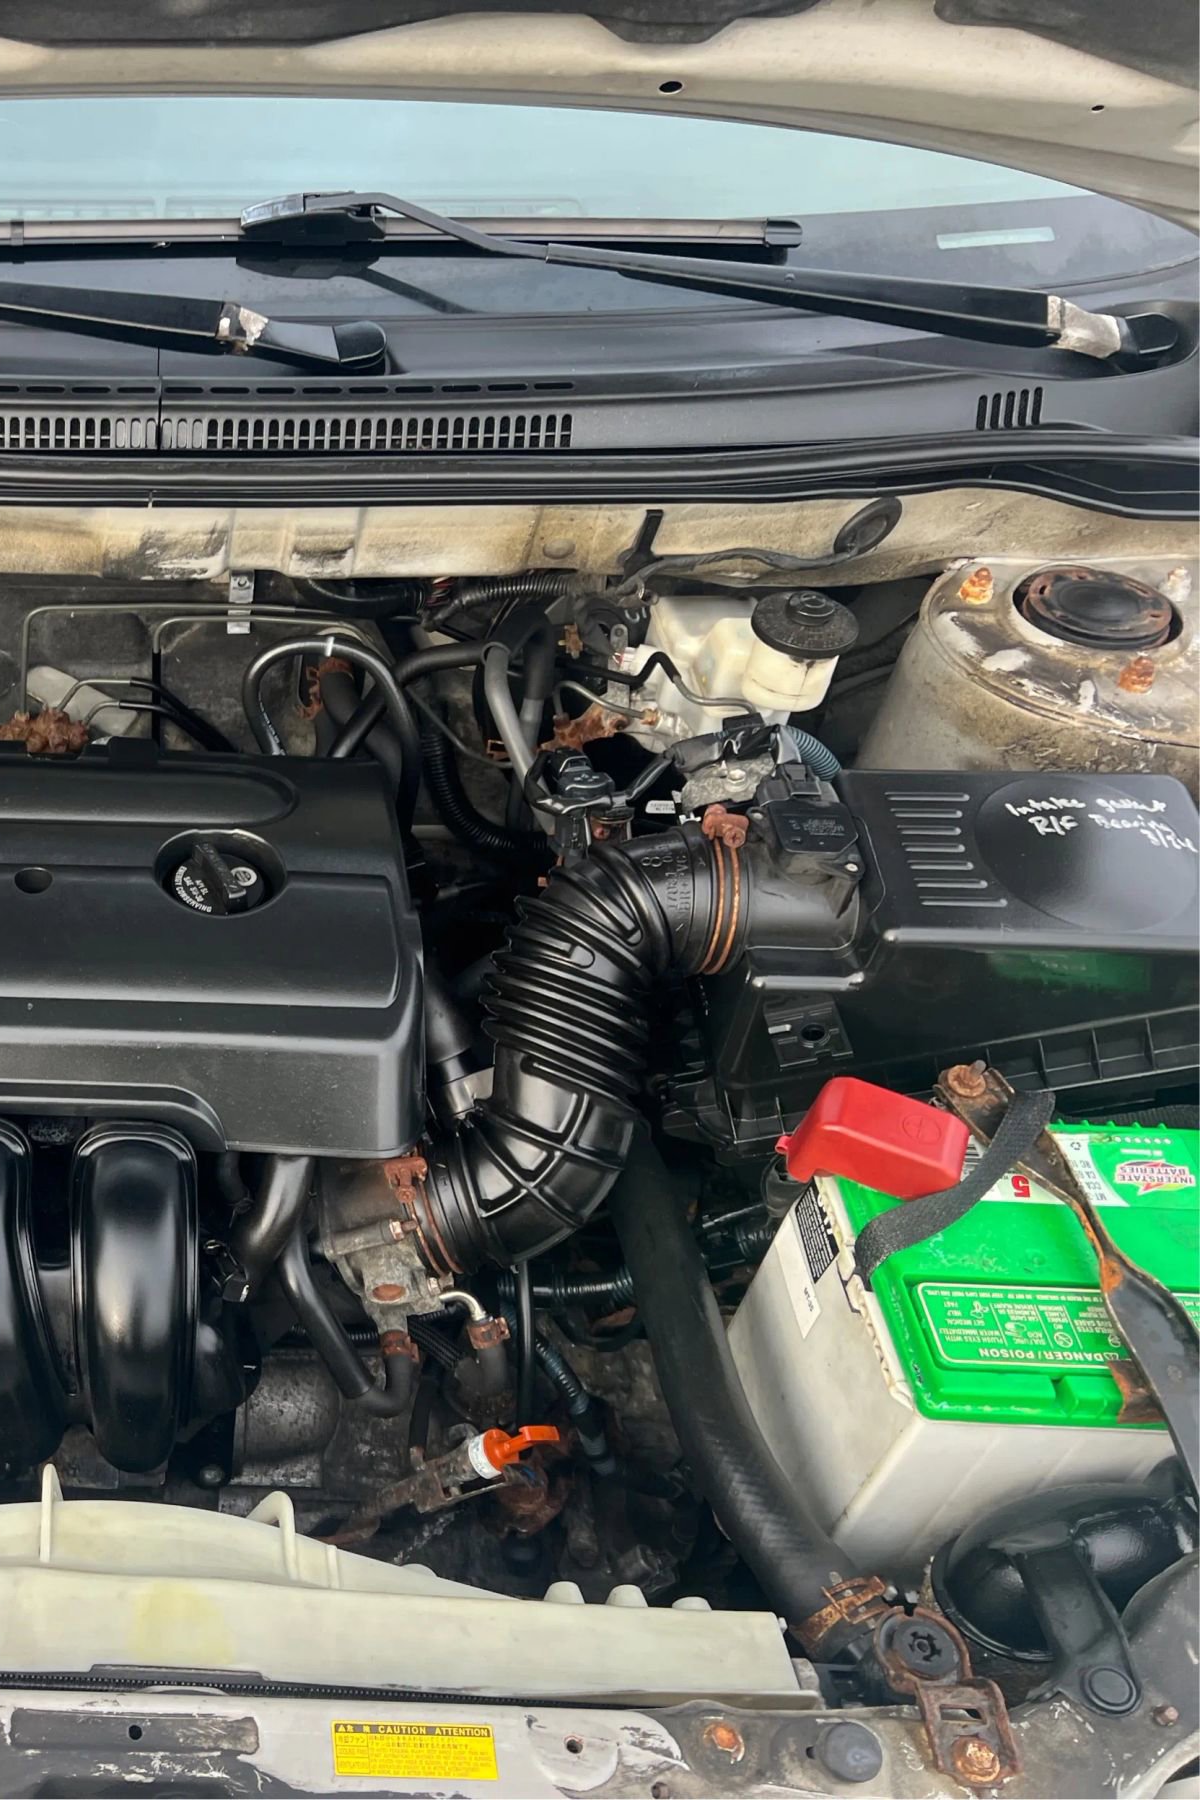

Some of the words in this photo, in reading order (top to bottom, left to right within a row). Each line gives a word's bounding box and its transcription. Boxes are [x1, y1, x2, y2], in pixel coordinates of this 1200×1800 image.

[175, 886, 213, 913] CONSERVING
[1119, 1166, 1187, 1176] BATTERIES
[1118, 1174, 1193, 1185] INTERSTATE
[1011, 1174, 1031, 1198] 5
[978, 1347, 1035, 1359] POISON
[1042, 1350, 1105, 1362] DANGER
[378, 1725, 427, 1735] CAUTION
[435, 1727, 489, 1737] ATTENTION
